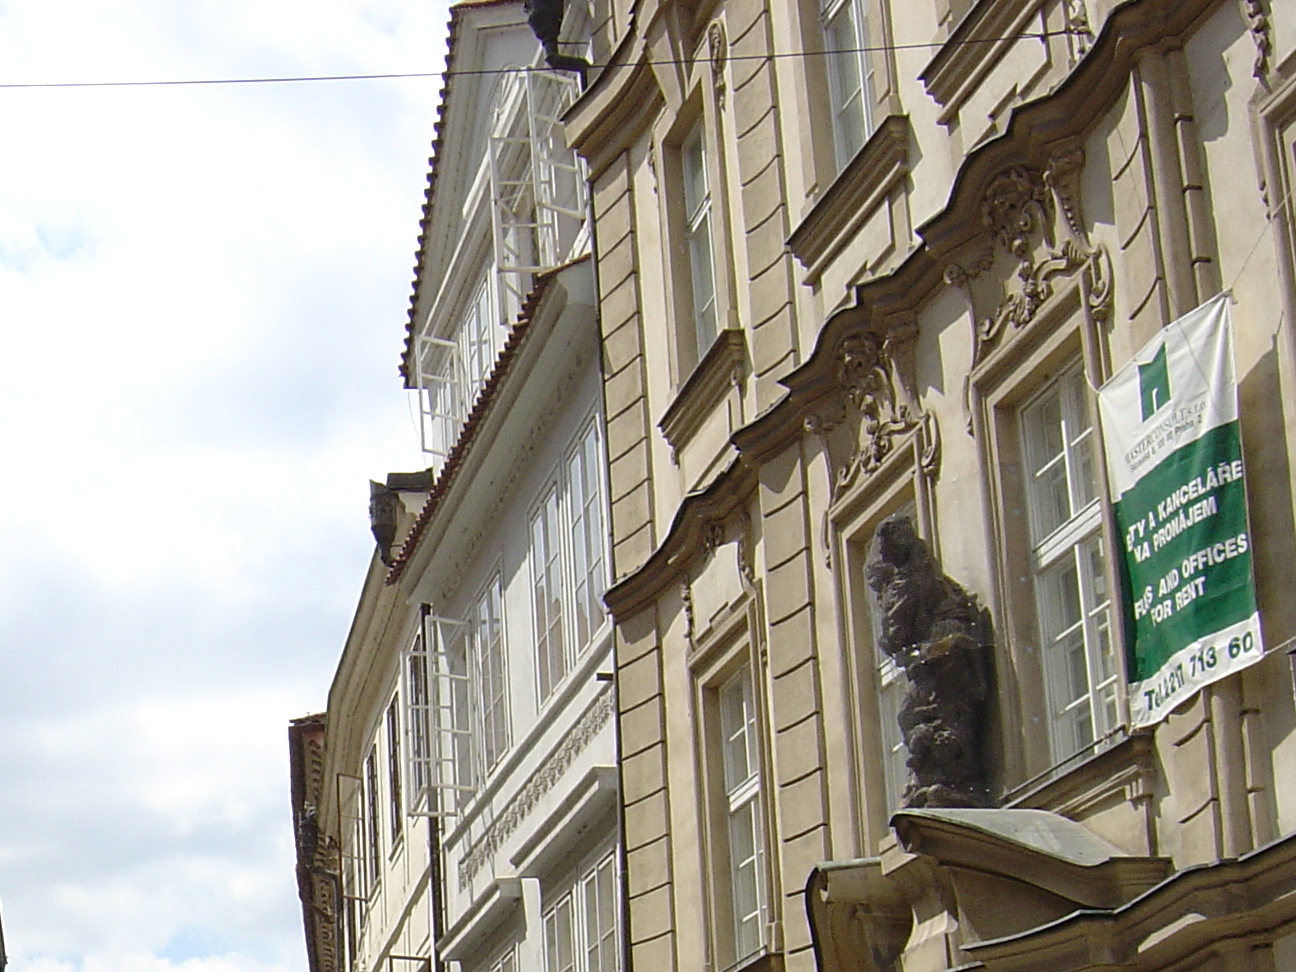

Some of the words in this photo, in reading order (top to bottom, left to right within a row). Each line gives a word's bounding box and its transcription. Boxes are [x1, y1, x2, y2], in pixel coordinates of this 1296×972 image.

[1148, 511, 1156, 531] A
[1157, 460, 1244, 521] KANCELÁŘE
[1153, 495, 1218, 552] PRONÁJEM
[1158, 569, 1179, 599] AND
[1181, 533, 1248, 579] OFFICES
[1151, 599, 1173, 627] FOR
[1175, 576, 1206, 612] RENT
[1228, 631, 1253, 659] 60
